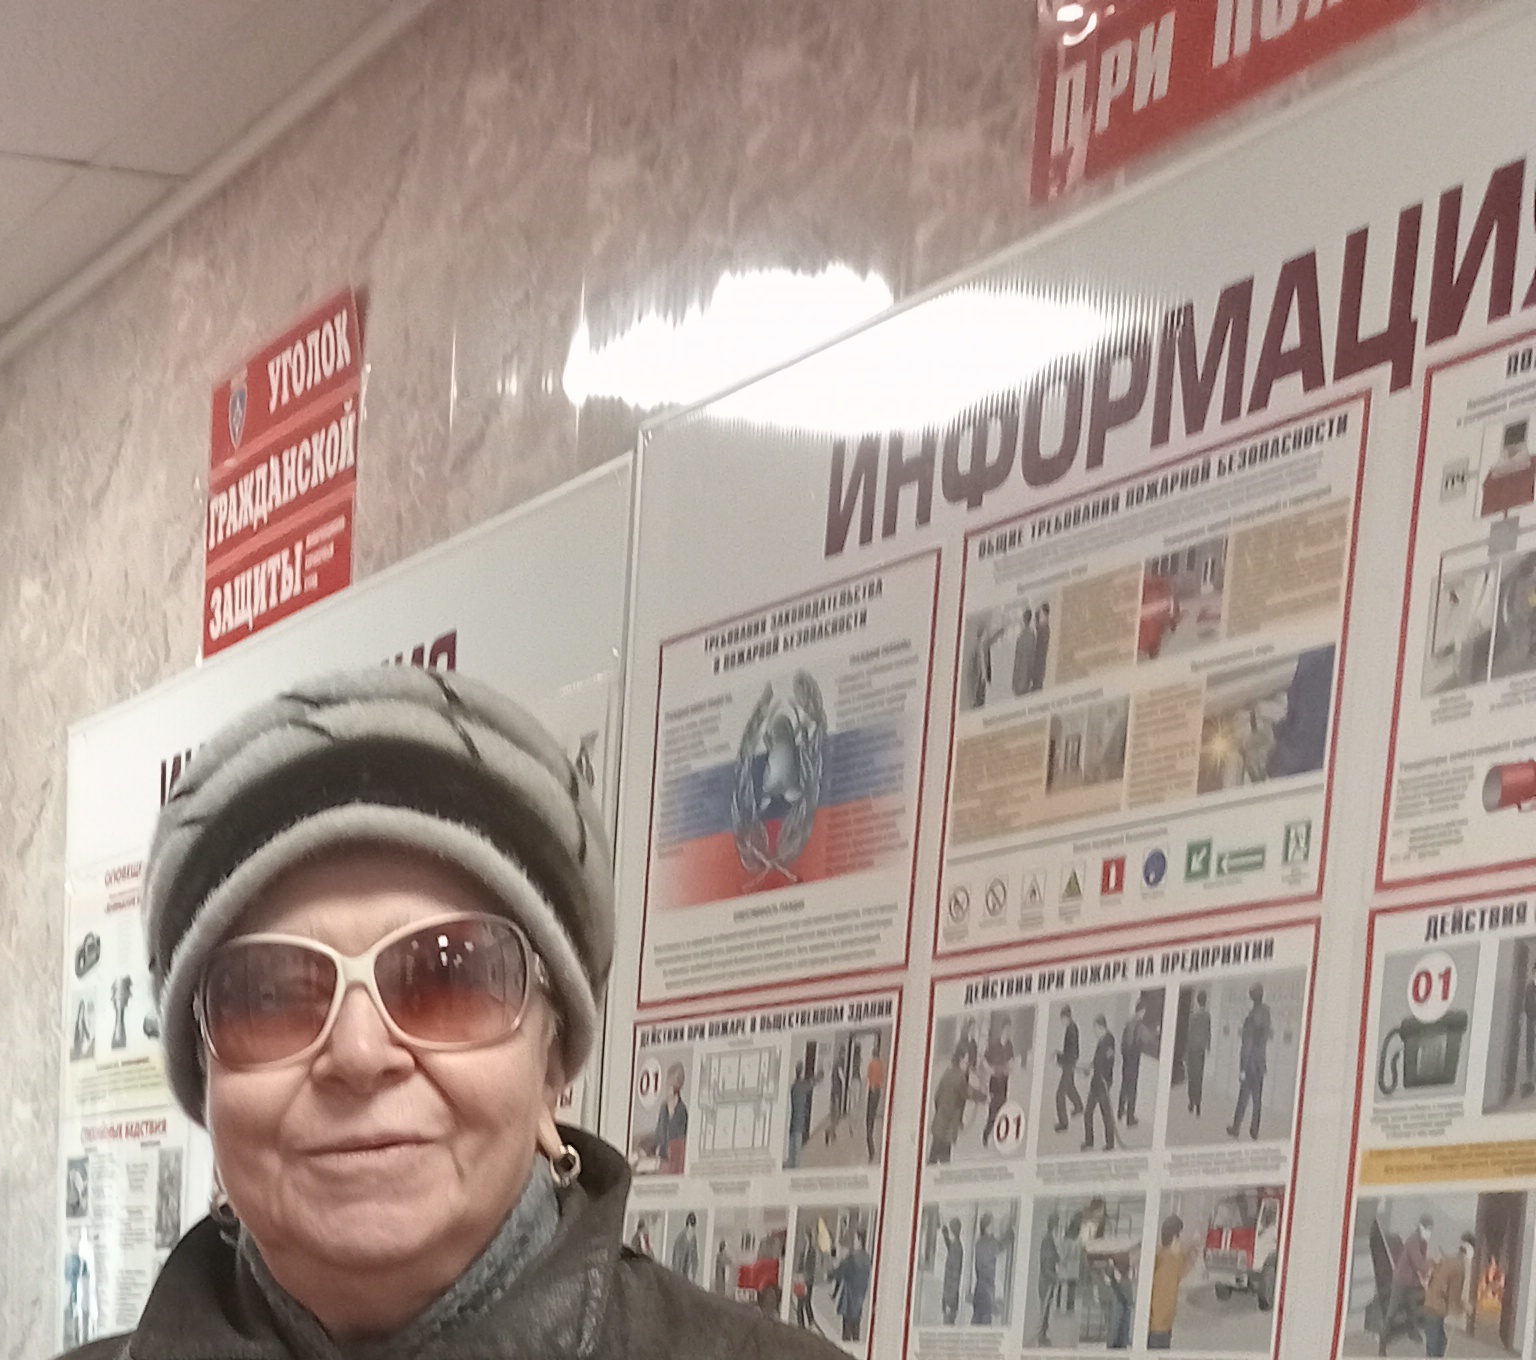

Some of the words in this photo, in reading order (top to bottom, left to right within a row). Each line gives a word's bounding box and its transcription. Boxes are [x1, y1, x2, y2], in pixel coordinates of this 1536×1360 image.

[1050, 12, 1175, 158] ПРИ
[268, 308, 351, 414] УГОЛОК
[825, 159, 1536, 559] ИНФОРМАЦИ
[208, 398, 356, 551] ГРАЖДАНСКОЙ
[978, 526, 1023, 560] ОБЩИЕ
[1031, 491, 1120, 540] ТРЕБОВАНИЯ
[1125, 455, 1211, 509] ПОЖАРНОЙ
[1217, 412, 1348, 478] БЕЗОПАСНОСТИ
[209, 540, 303, 641] ЗАЩИТЫ
[1425, 901, 1528, 943] ДЕЙСТВИЯ
[964, 973, 1032, 1006] ДЕЙСТВИЯ
[1037, 969, 1065, 992] ПРИ
[1070, 959, 1127, 988] ПОЖАРЕ
[1135, 954, 1154, 977] НА
[1161, 937, 1274, 974] ПРЕДПРИЯТИИ
[1412, 966, 1452, 1004] 01
[687, 1022, 705, 1040] ПРИ
[708, 1017, 746, 1038] ПОЖАРЕ
[760, 1004, 844, 1032] ОБЩЕСТВЕННОМ
[848, 999, 892, 1022] ЗДАНИИ
[638, 1066, 660, 1097] 01
[996, 1114, 1024, 1143] 01
